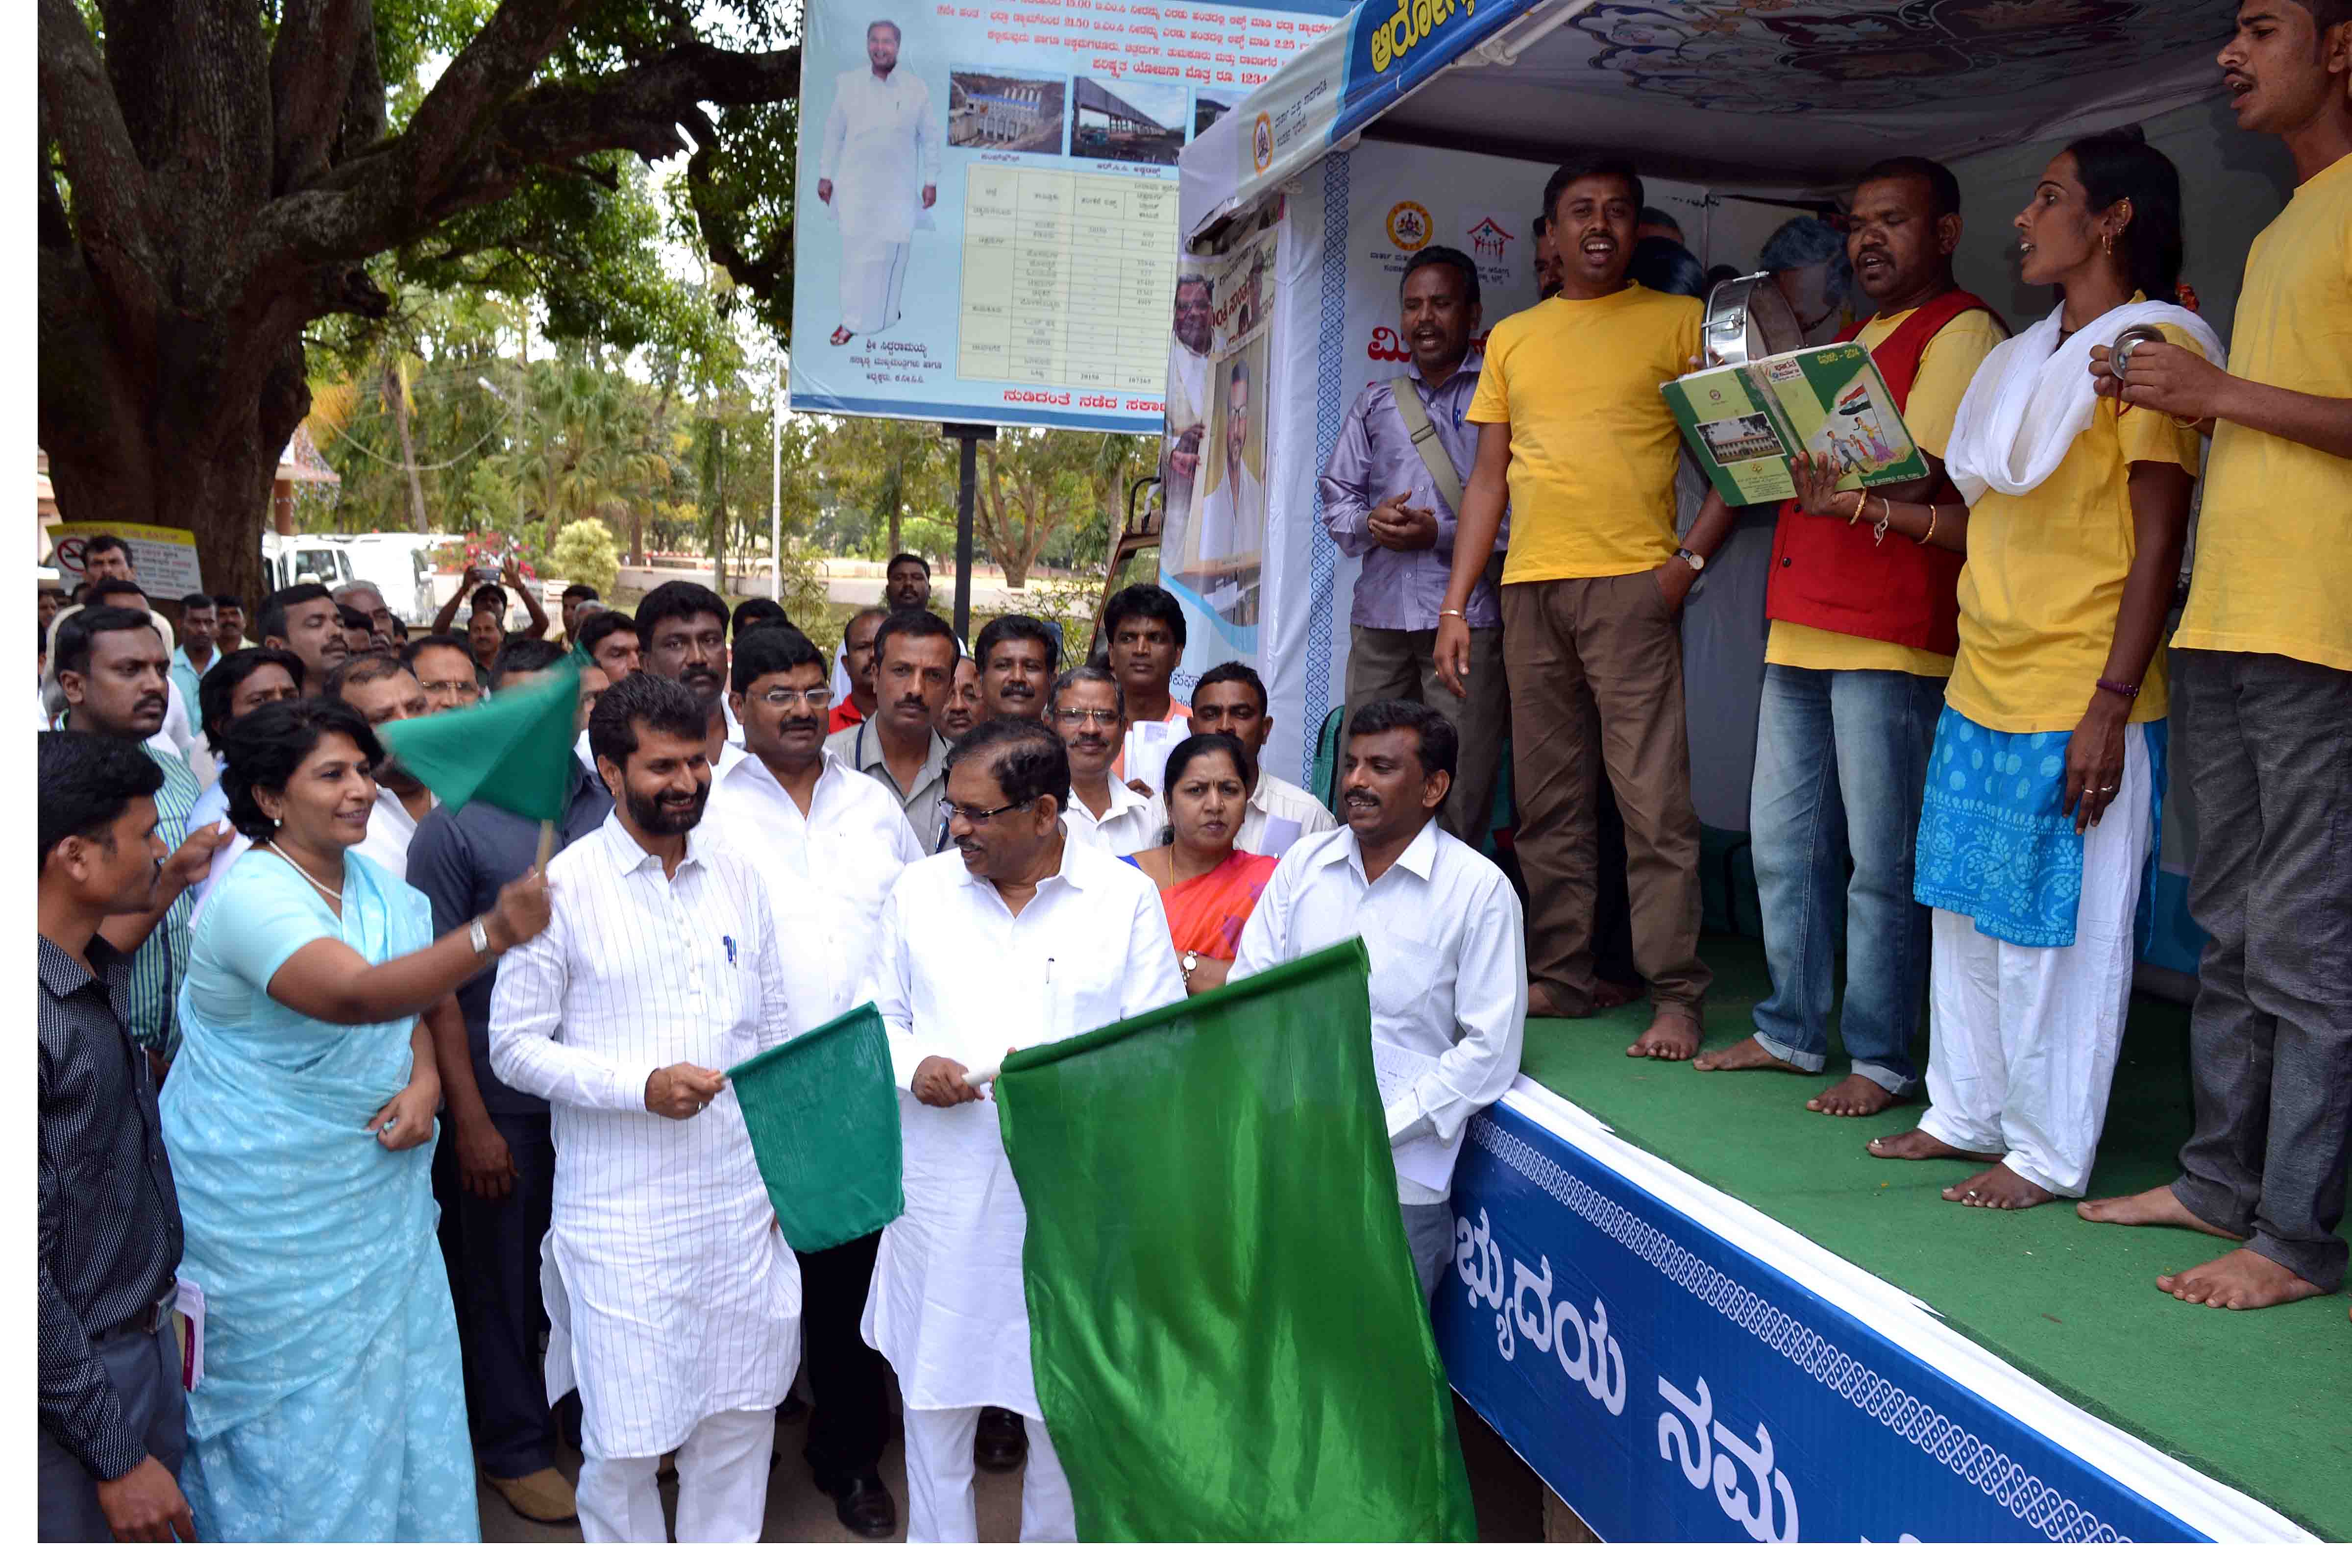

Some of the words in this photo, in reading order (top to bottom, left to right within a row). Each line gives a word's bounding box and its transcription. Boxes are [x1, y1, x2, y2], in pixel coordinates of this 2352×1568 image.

[1004, 388, 1071, 406] ನುಡಿದಂತೆ
[1079, 394, 1118, 409] ನಡೆದ
[1456, 1206, 1627, 1416] ಭ್ಯುದಯ
